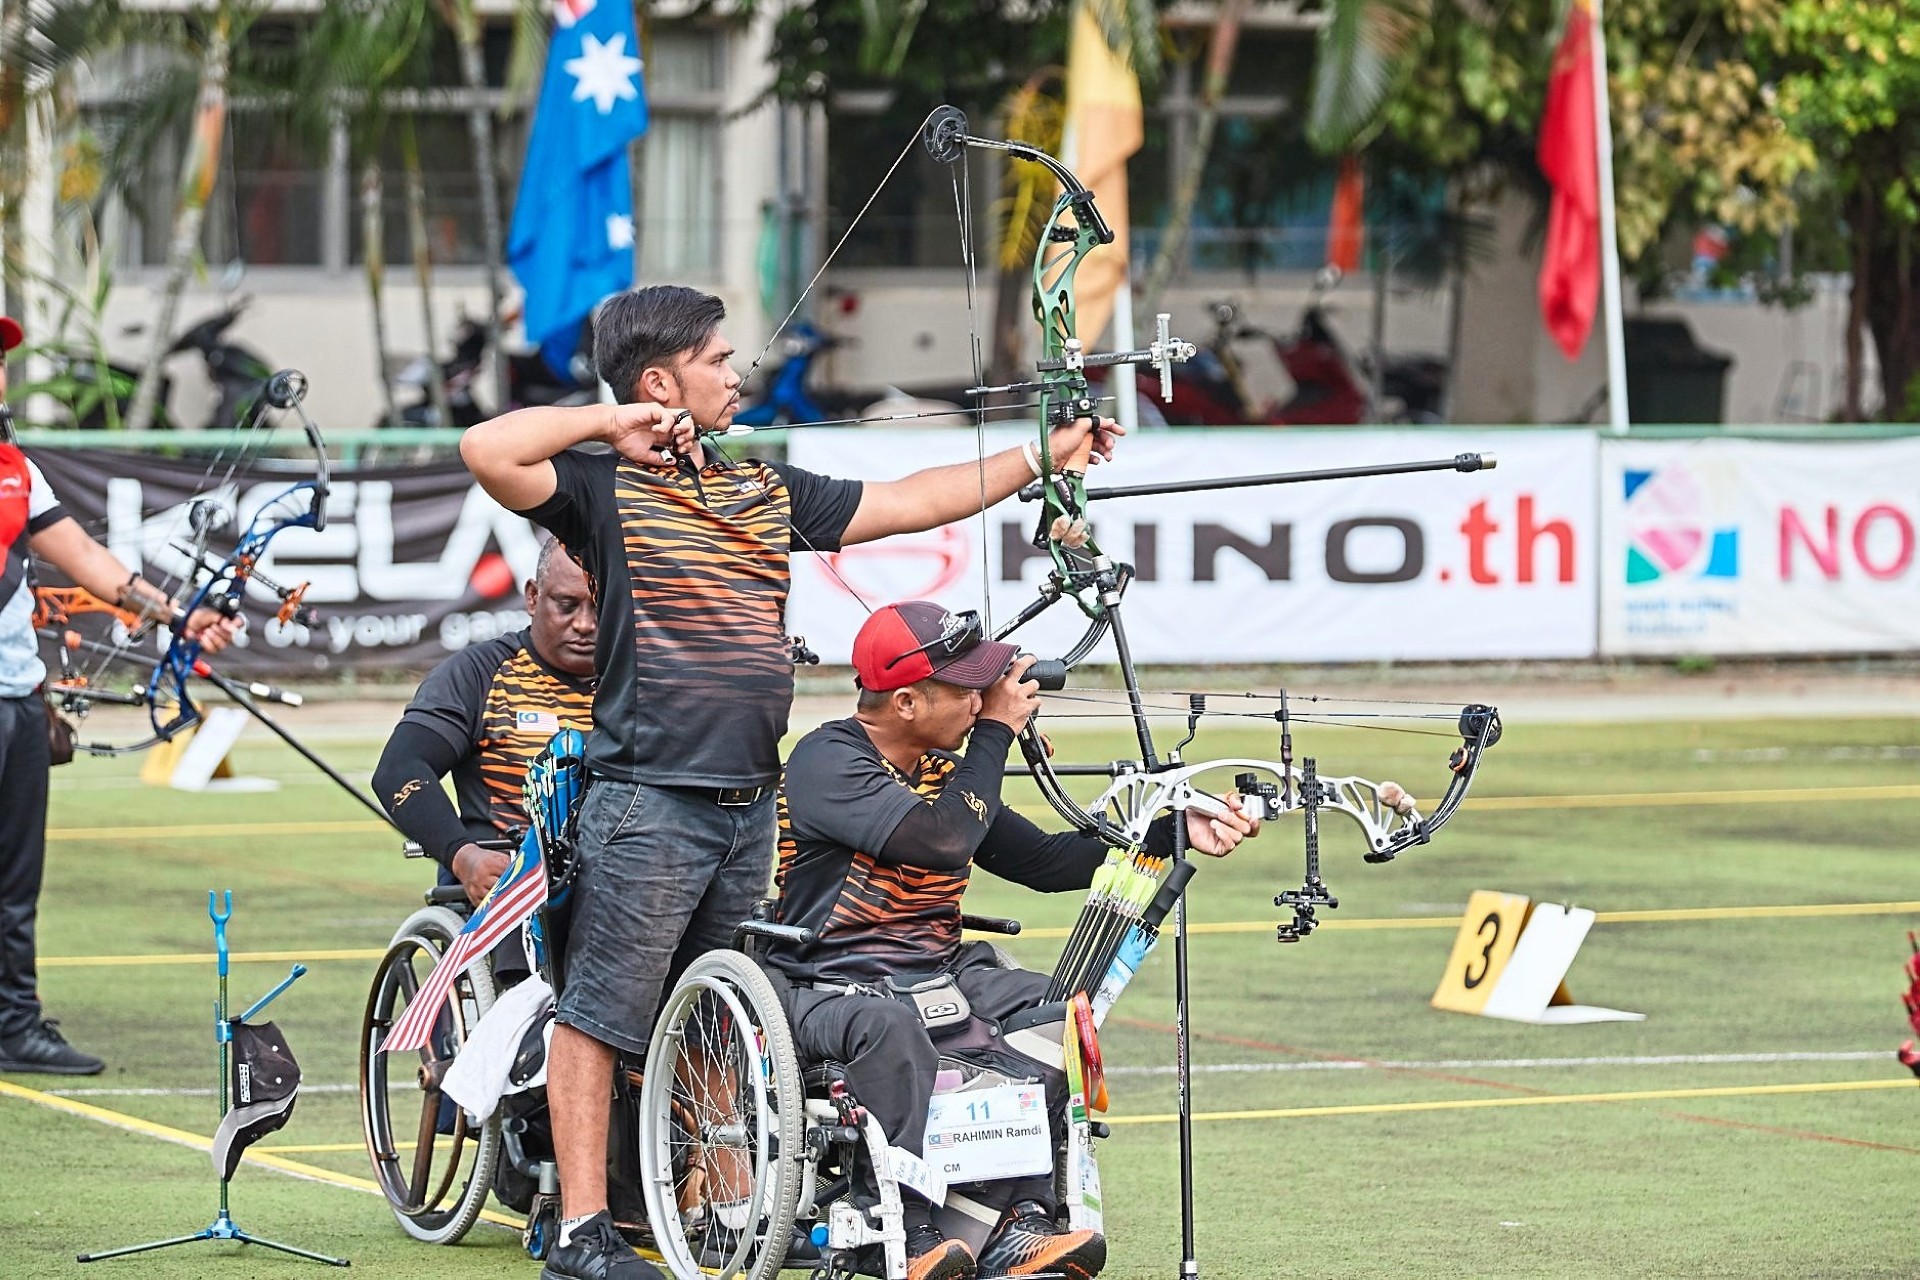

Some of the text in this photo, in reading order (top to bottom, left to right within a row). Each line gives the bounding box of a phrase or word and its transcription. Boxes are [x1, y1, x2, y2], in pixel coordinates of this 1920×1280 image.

[1779, 505, 1915, 581] NO
[327, 614, 428, 654] your
[1464, 912, 1501, 989] 3
[966, 1100, 990, 1121] 11
[952, 1128, 1003, 1143] RAHIMIN
[943, 1163, 961, 1173] CM
